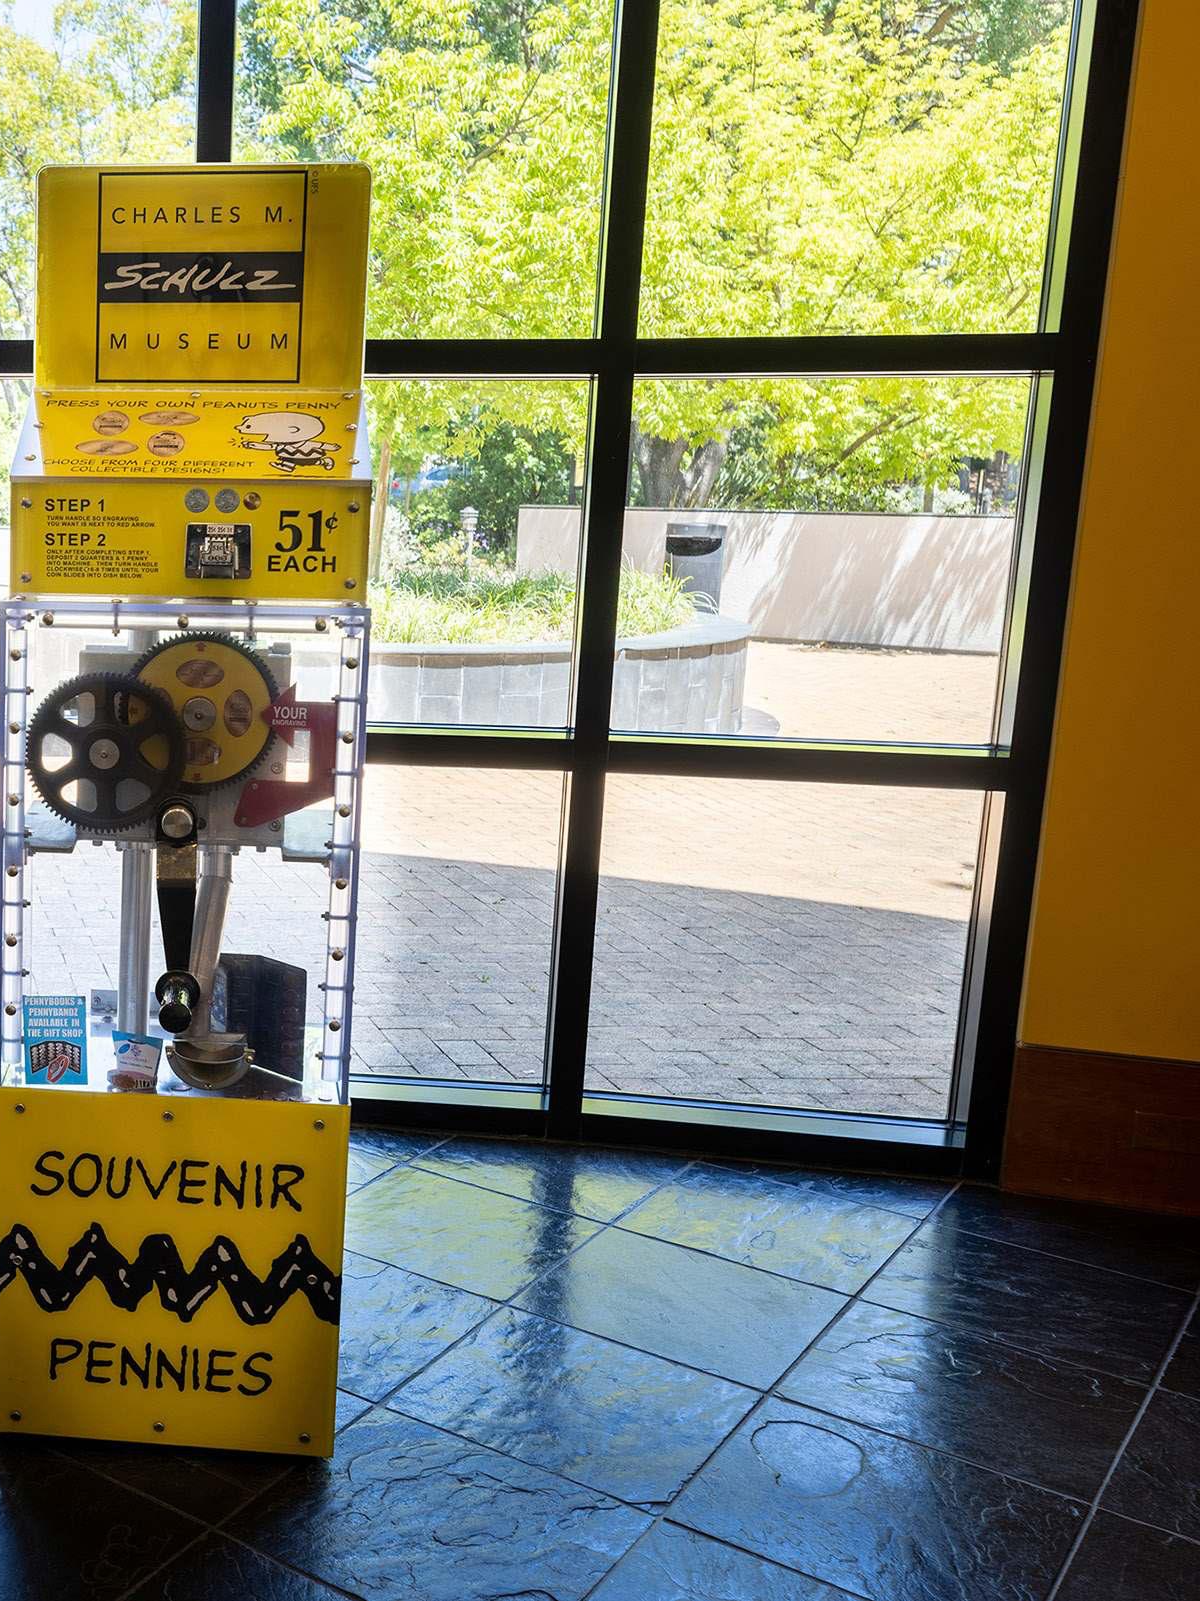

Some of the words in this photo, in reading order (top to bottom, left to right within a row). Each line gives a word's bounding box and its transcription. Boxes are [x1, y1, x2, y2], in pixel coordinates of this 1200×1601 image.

[111, 206, 241, 225] CHARLES
[264, 206, 294, 223] M.
[104, 261, 297, 294] SCHULZ
[110, 333, 288, 350] MUSEUM
[46, 400, 100, 408] PRESS
[107, 400, 149, 408] YOUR
[155, 400, 196, 409] OWN
[203, 401, 279, 409] PEANUTS
[286, 402, 342, 410] PENNY
[43, 458, 96, 466] CHOOSE
[101, 459, 139, 467] FROM
[183, 460, 256, 468] DIFFERENT
[44, 499, 91, 512] STEP
[97, 499, 105, 512] 1
[44, 533, 90, 546] STEP
[97, 533, 106, 546] 2
[267, 555, 337, 573] EACH
[273, 706, 307, 720] YOUR
[28, 1018, 69, 1027] AVAILABLE
[71, 1018, 80, 1027] IN
[27, 1028, 42, 1038] THE
[43, 1028, 61, 1038] GIFT
[62, 1029, 84, 1038] SHOP
[30, 1150, 305, 1212] SOUVENIR
[49, 1338, 273, 1396] PENNIES
